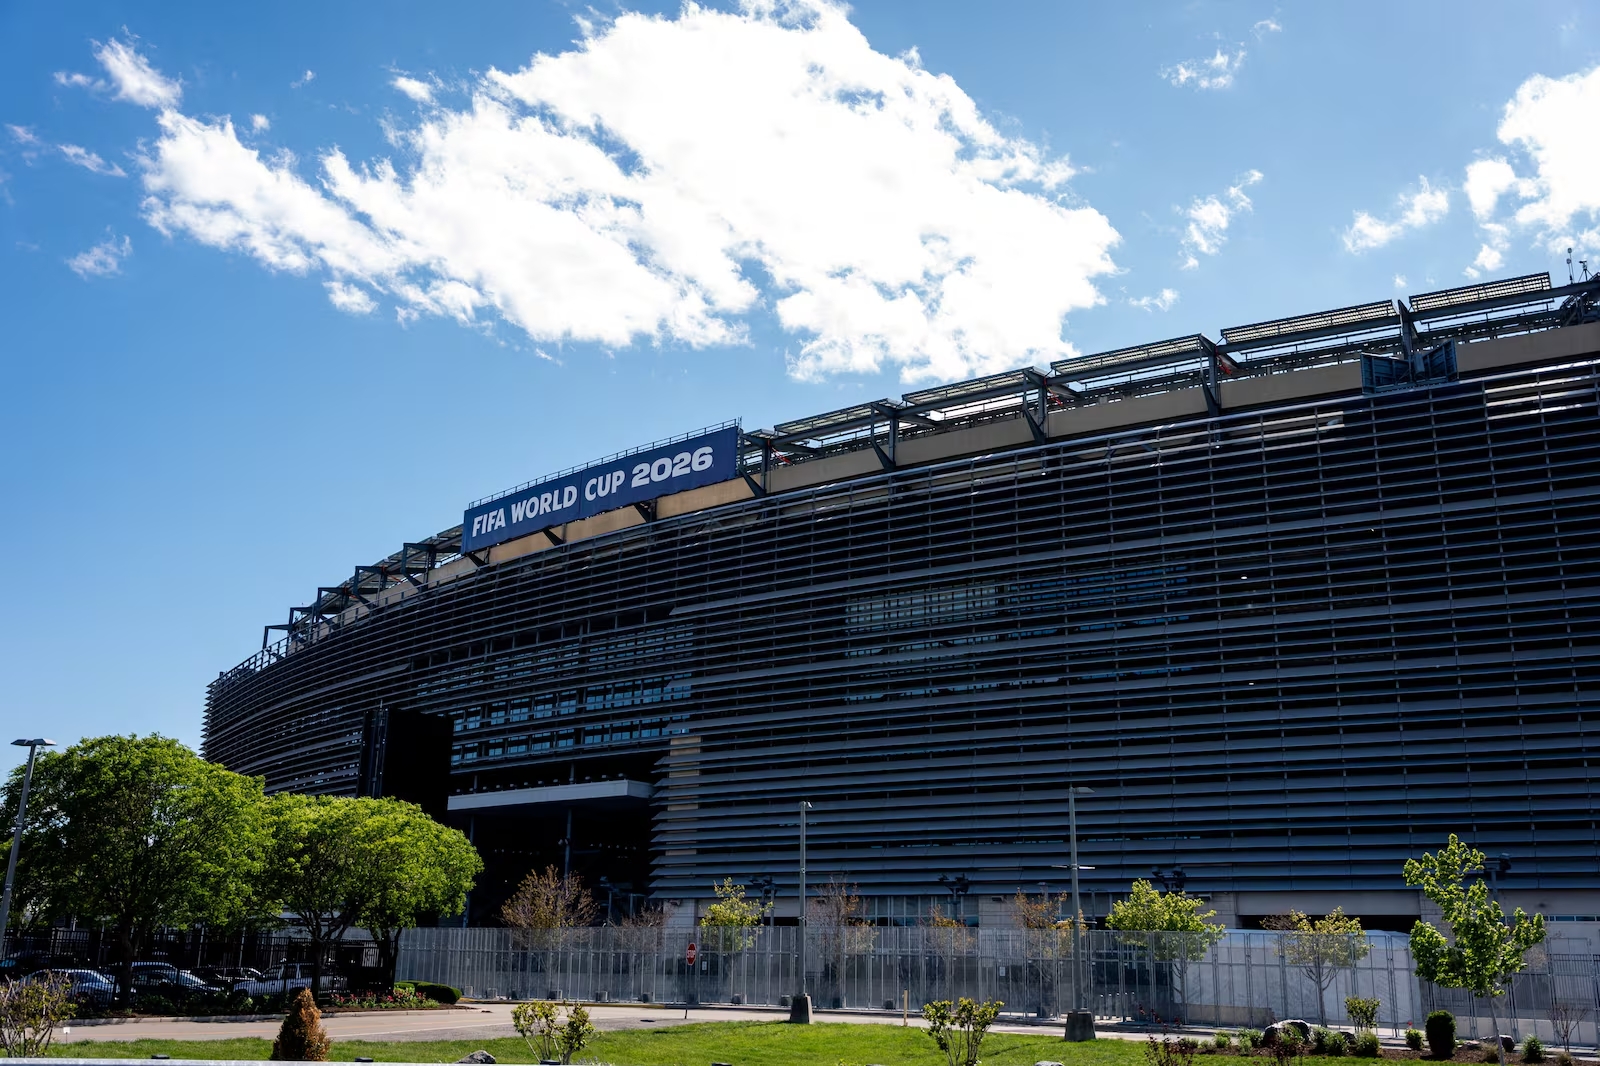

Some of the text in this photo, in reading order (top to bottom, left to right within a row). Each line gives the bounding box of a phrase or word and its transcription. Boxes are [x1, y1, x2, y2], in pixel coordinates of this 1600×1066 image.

[472, 446, 714, 538] FIFA WORLD CUP 2026
[687, 950, 696, 958] STOP
